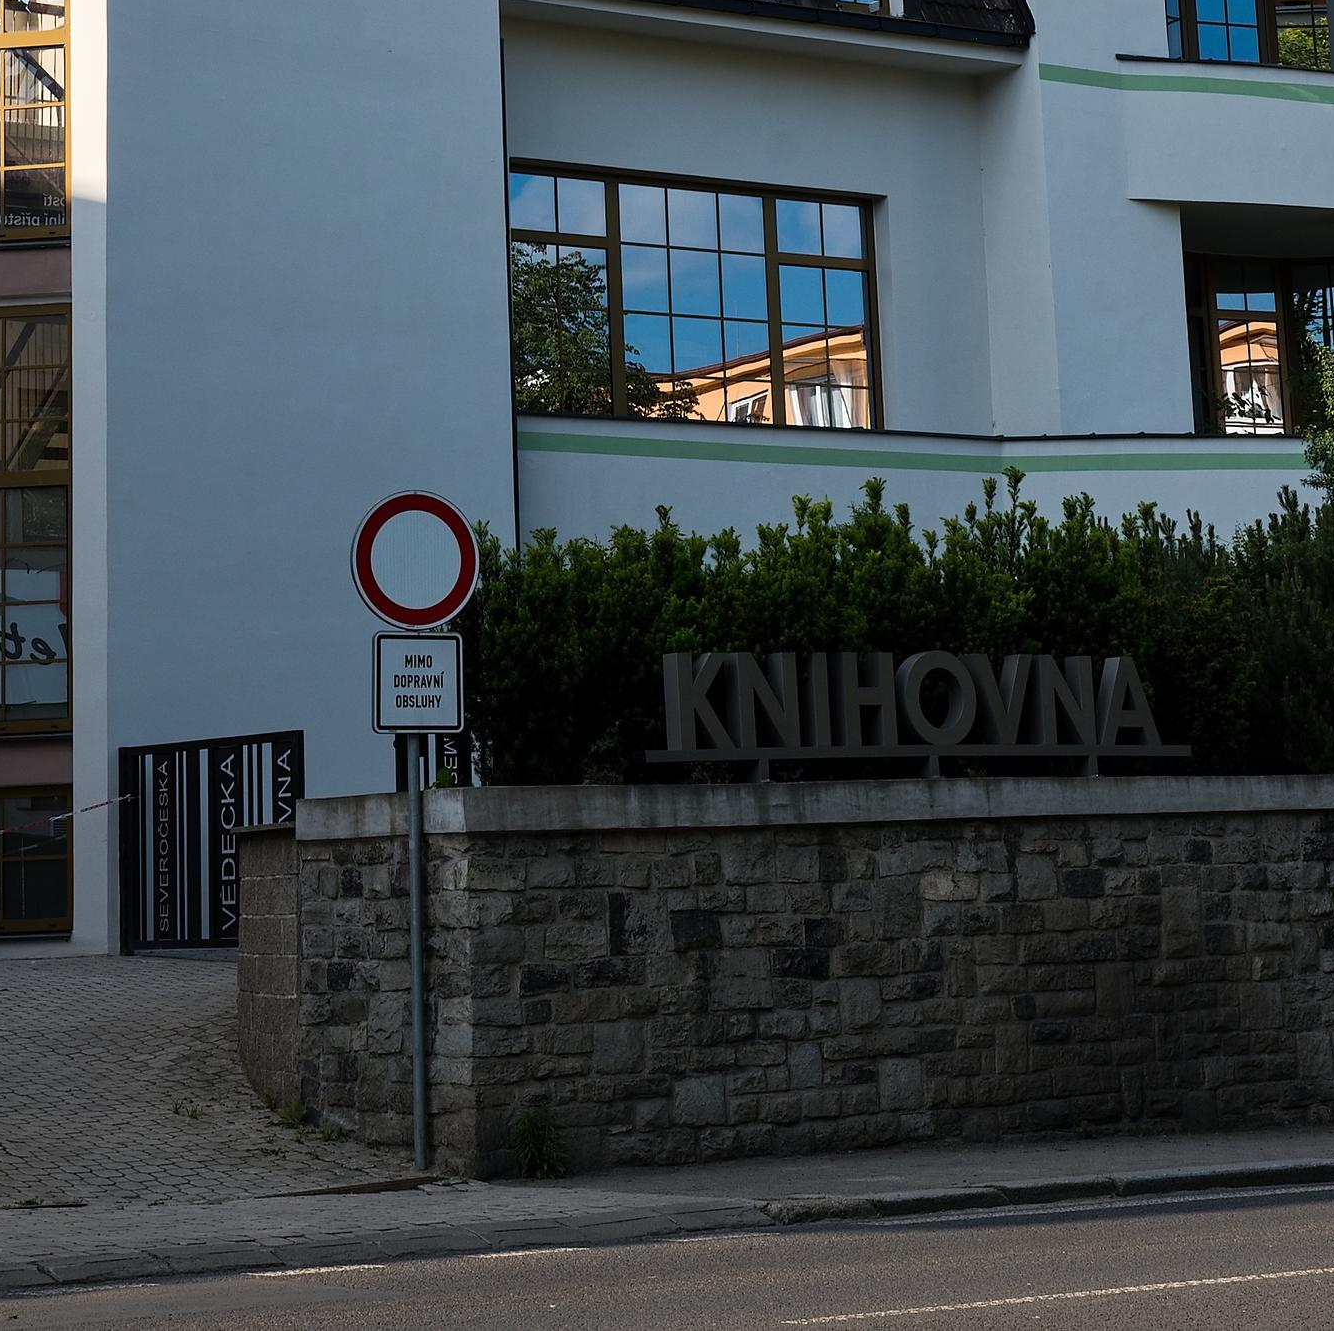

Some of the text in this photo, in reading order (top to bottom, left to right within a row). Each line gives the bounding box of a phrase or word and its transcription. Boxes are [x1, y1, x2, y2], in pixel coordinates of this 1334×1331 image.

[405, 655, 432, 668] MIMO
[394, 671, 444, 688] DOPRAVNÍ
[396, 695, 442, 708] OBSLUHY
[663, 650, 1163, 751] KNIHOVNA
